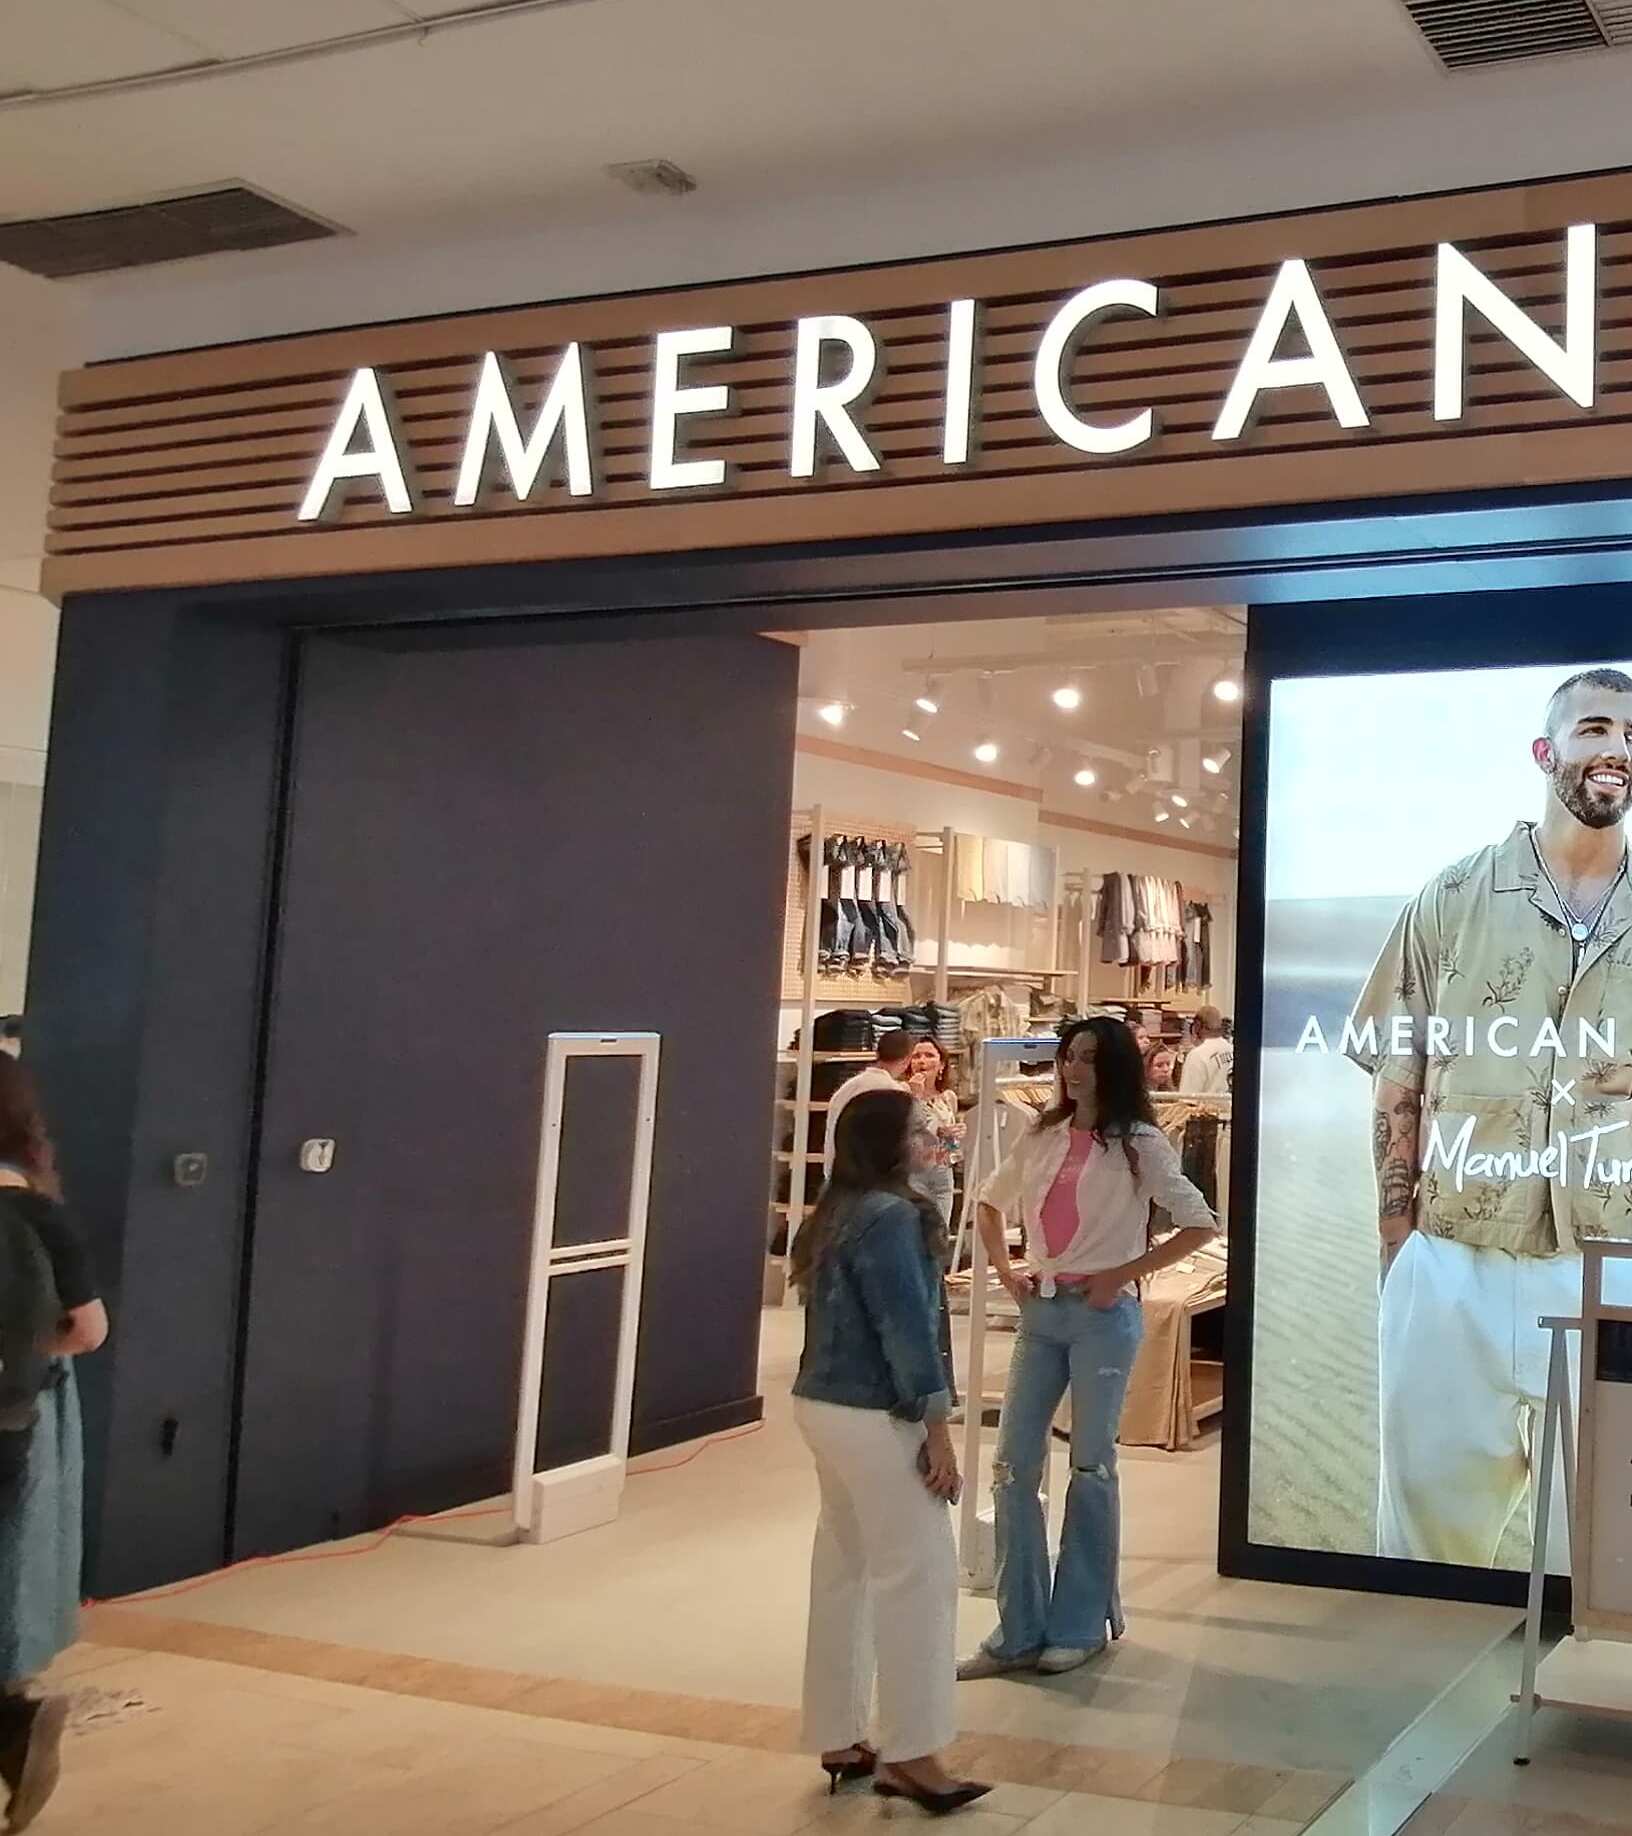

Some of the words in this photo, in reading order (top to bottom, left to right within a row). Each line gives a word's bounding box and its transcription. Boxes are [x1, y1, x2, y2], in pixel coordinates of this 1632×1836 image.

[297, 223, 1596, 521] AMERICAN
[1296, 1015, 1616, 1058] AMERICAN
[1419, 1115, 1568, 1193] Manuel
